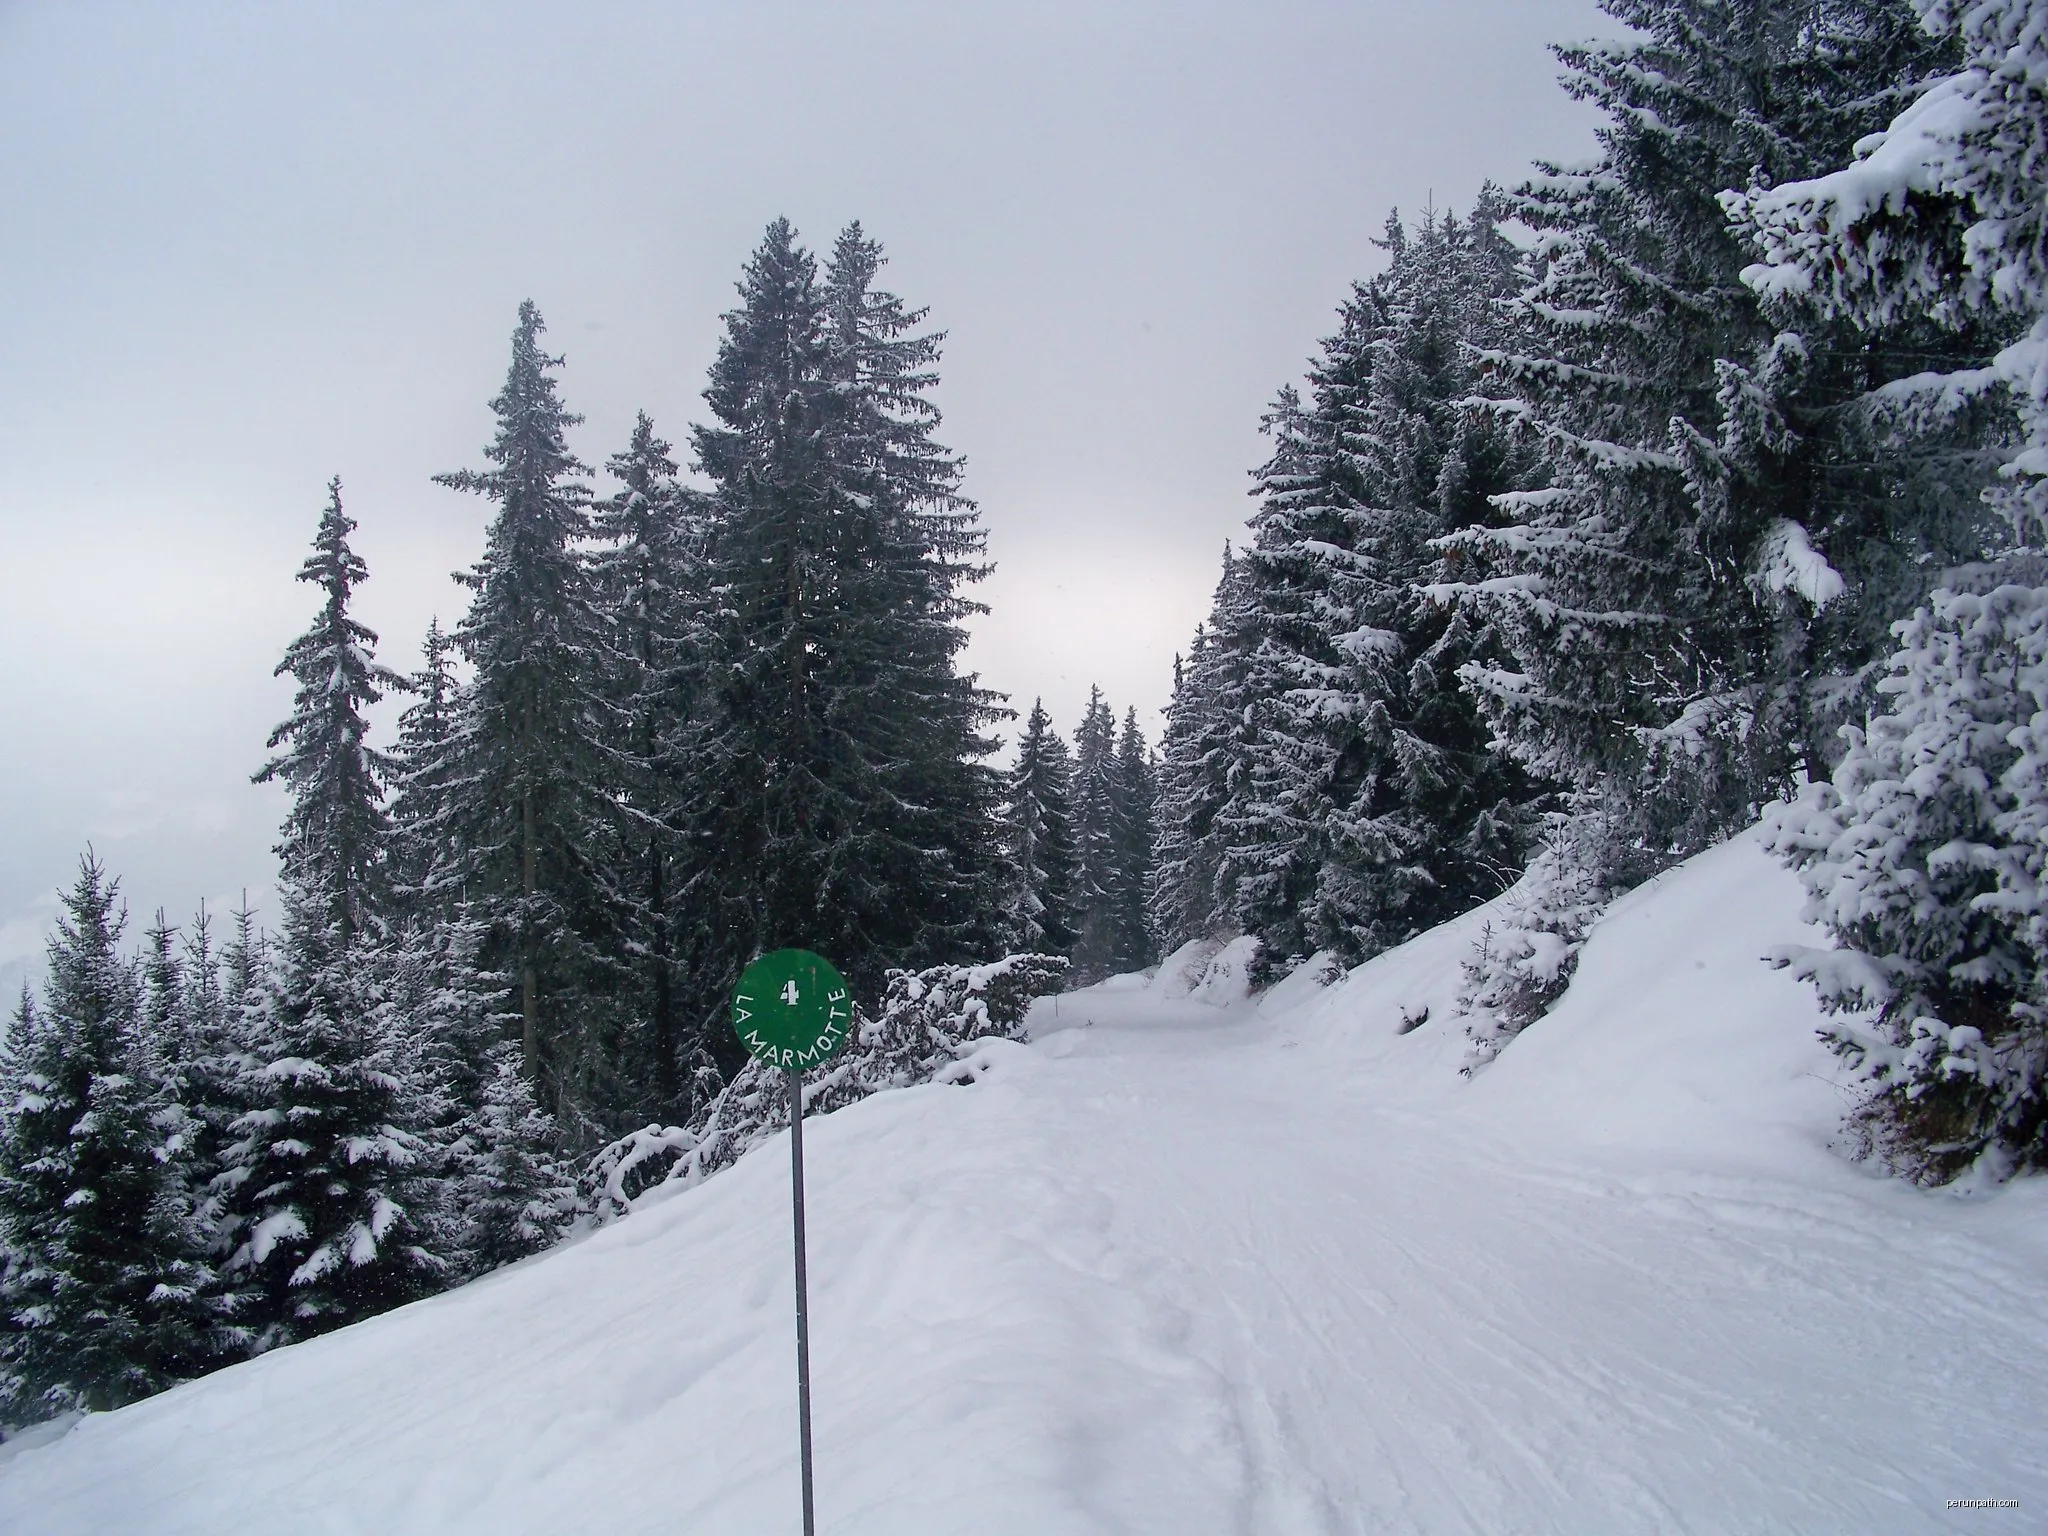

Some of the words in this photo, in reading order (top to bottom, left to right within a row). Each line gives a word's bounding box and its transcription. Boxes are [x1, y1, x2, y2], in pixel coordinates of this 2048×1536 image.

[780, 980, 799, 1005] 4
[736, 995, 754, 1024] LA
[744, 988, 846, 1067] MARMOTTE
